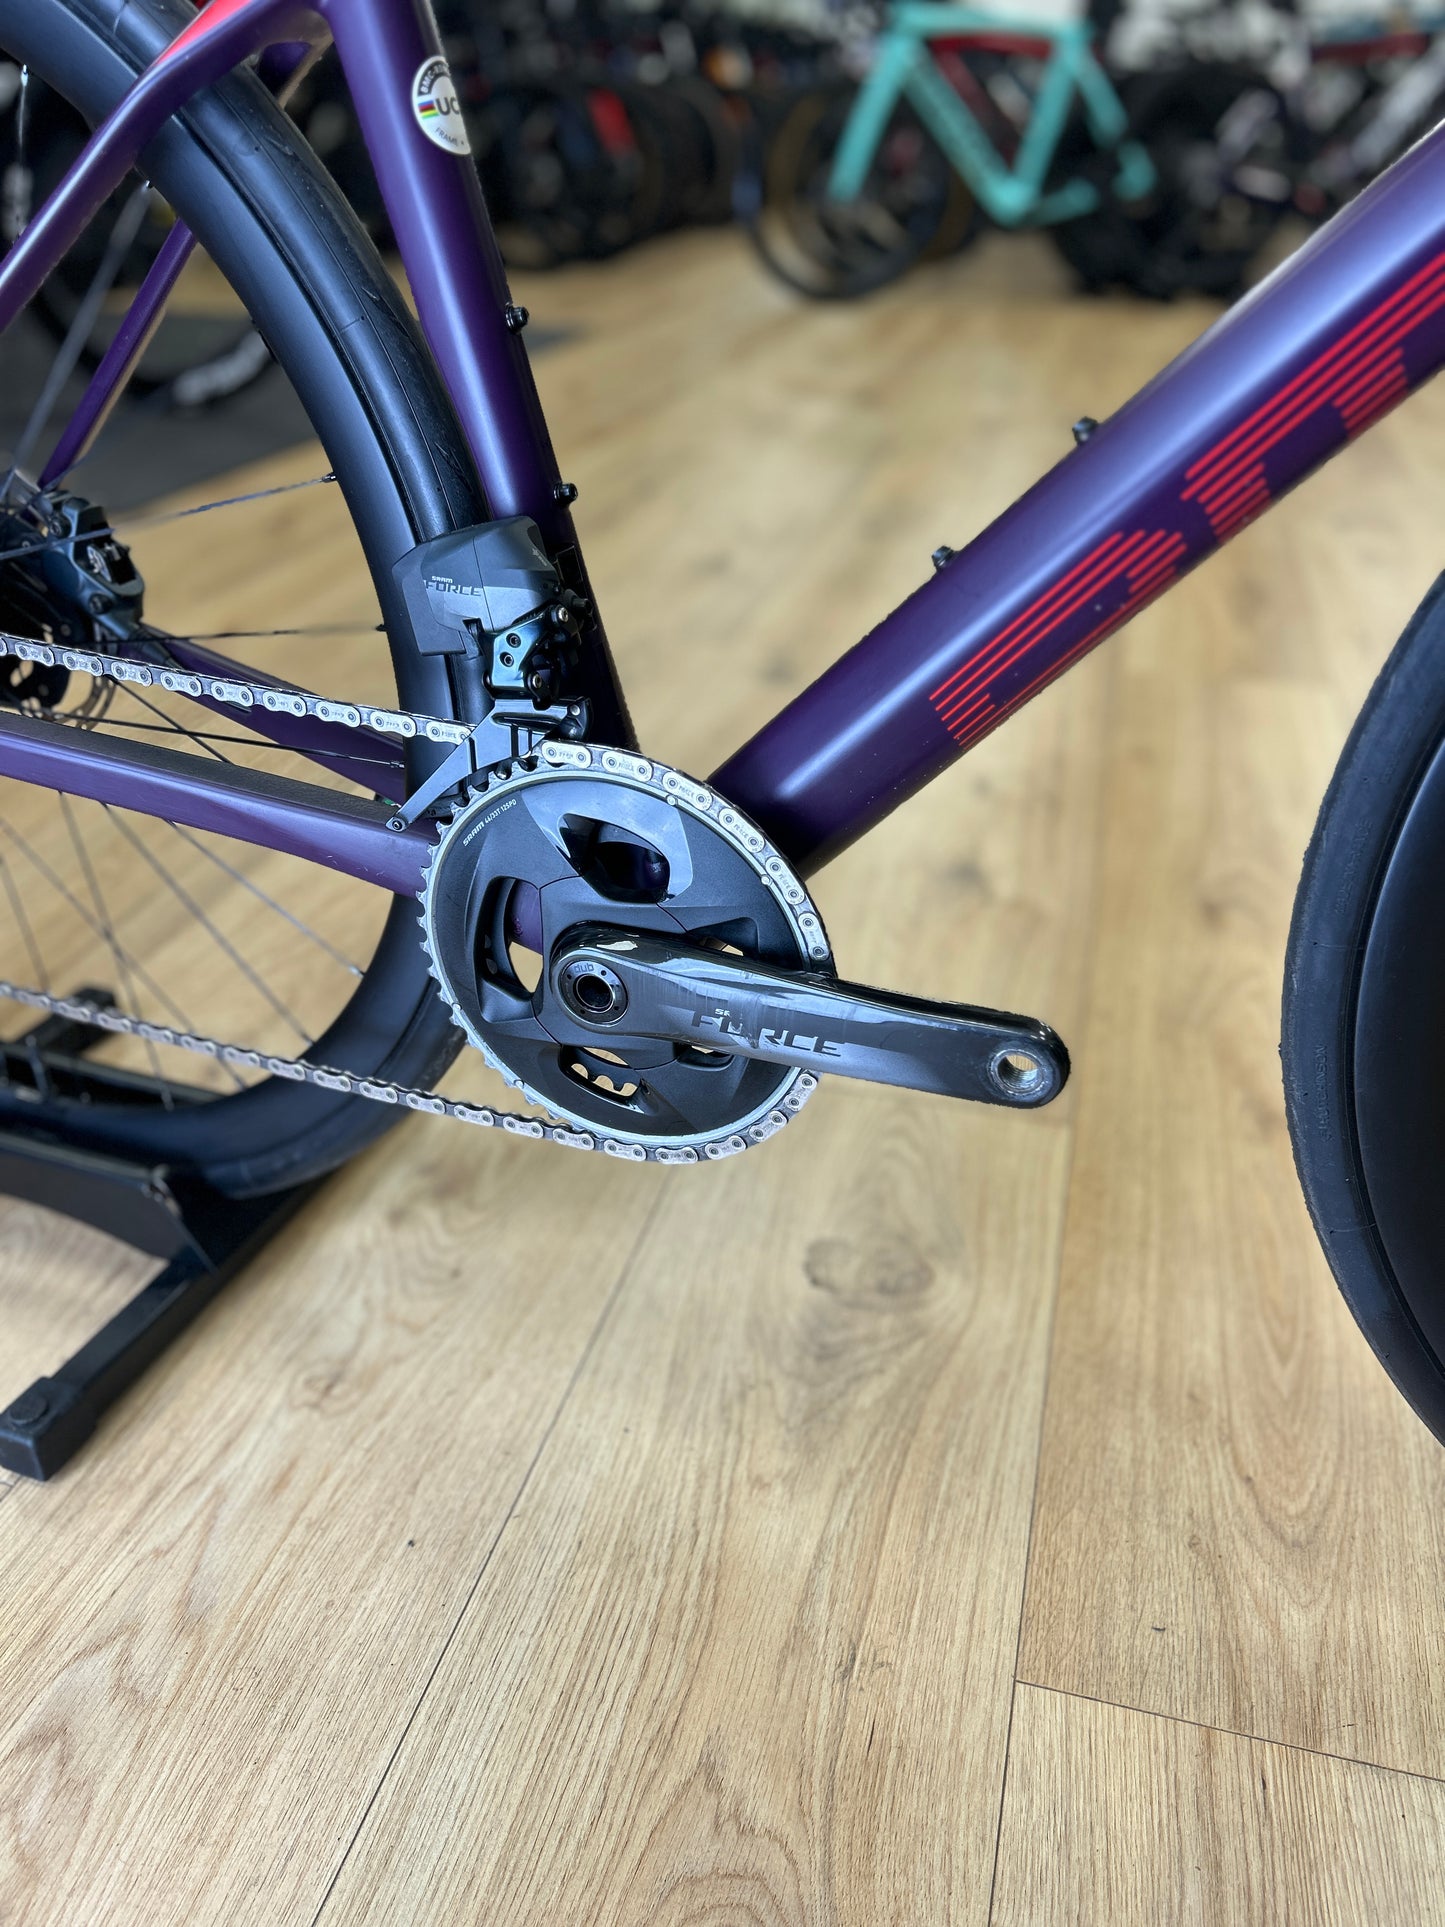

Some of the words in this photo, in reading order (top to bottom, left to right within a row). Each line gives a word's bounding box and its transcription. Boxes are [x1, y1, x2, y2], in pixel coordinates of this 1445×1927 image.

[425, 581, 481, 597] FORCE
[463, 821, 485, 846] SRAM
[574, 962, 595, 974] dub
[691, 1010, 842, 1057] FORCE
